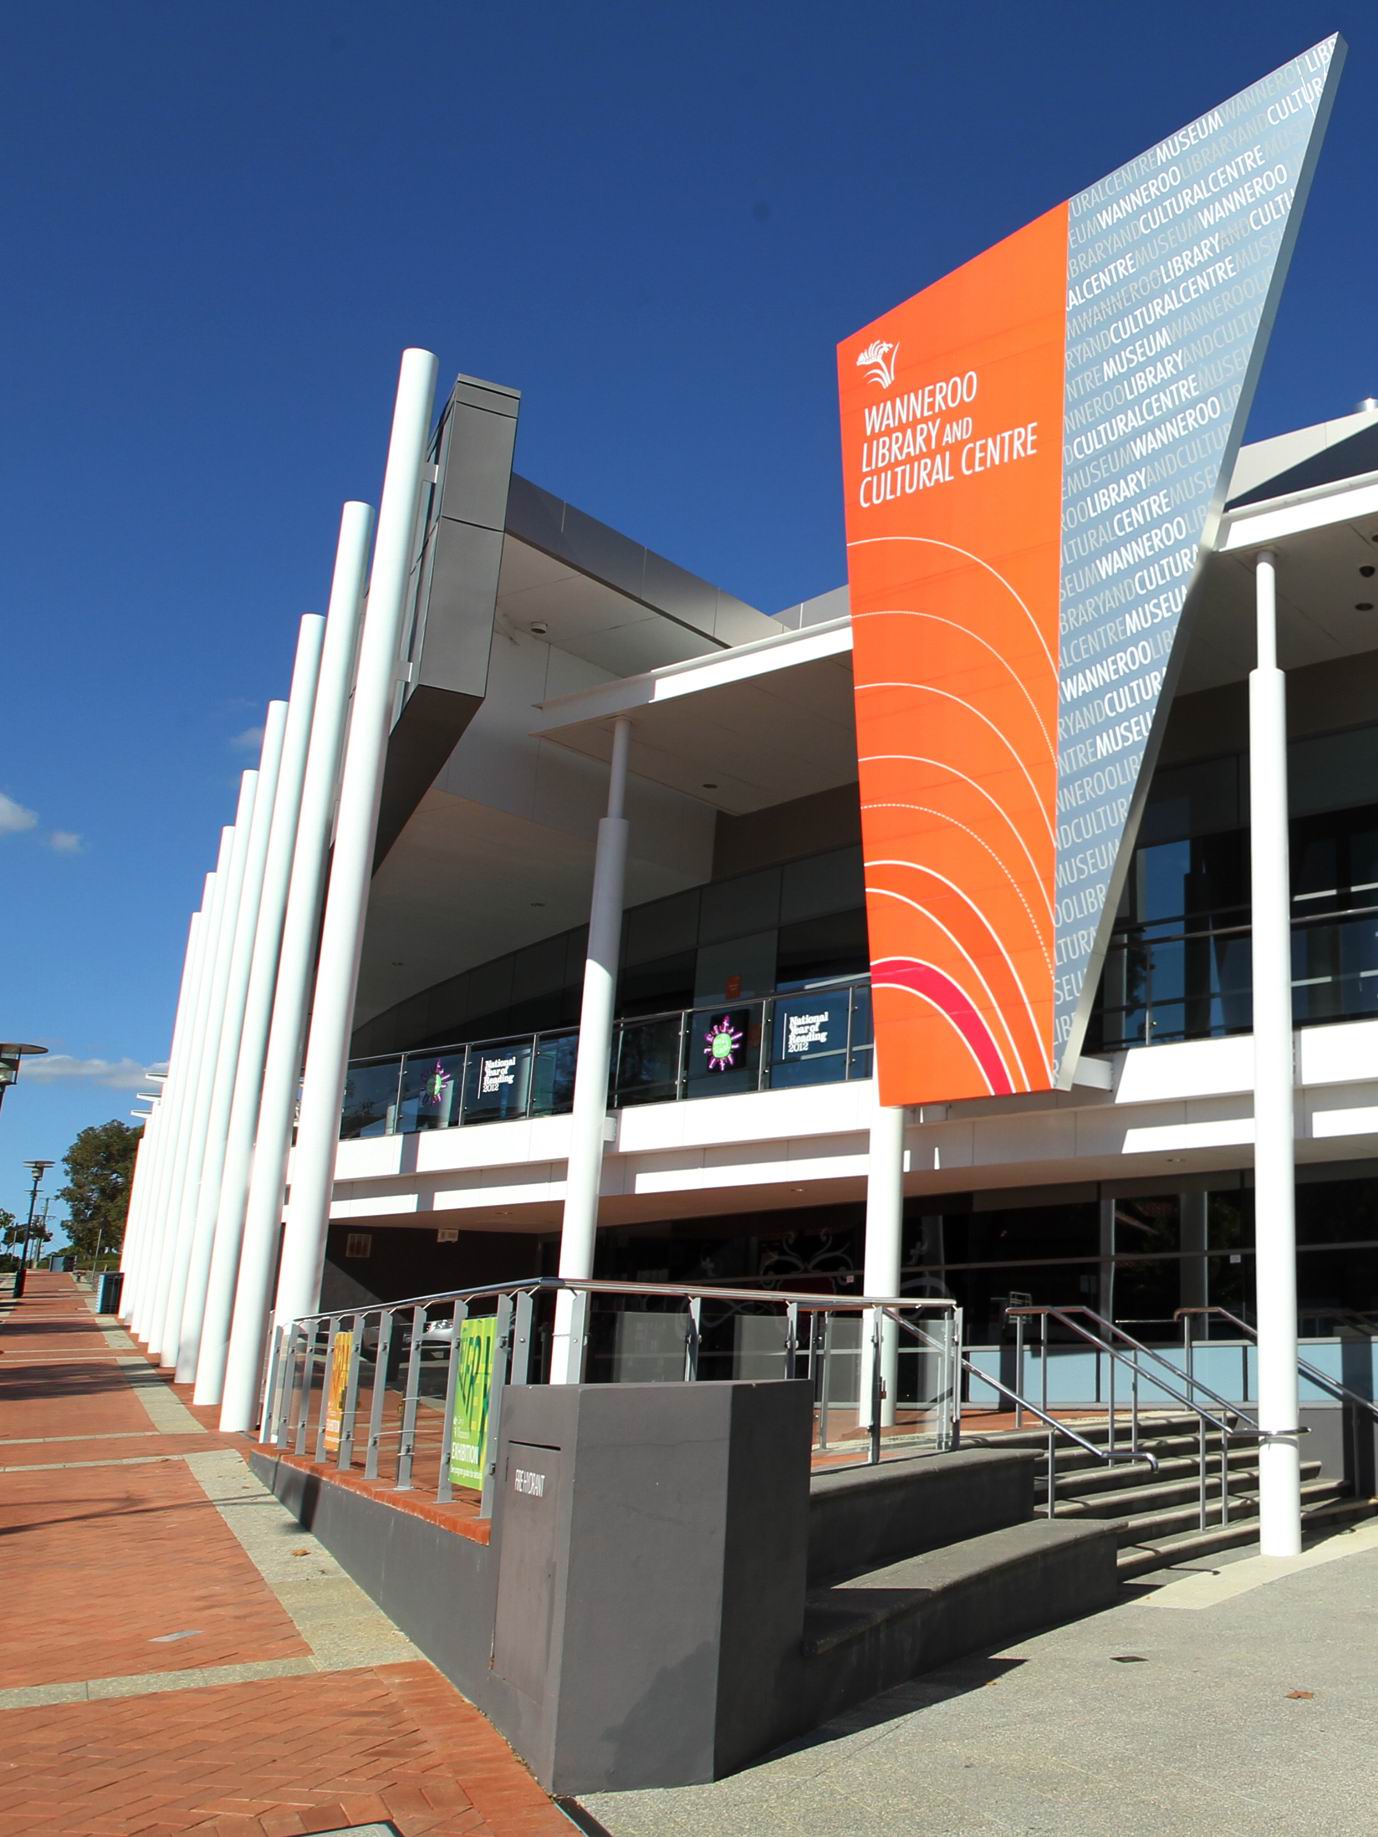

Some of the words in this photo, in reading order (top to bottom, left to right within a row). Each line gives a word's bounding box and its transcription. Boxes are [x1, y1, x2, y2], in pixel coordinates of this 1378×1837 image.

[1156, 111, 1223, 162] MUSEUM
[1096, 165, 1181, 229] WANNEROO
[1066, 254, 1136, 308] ALCENTRE
[1199, 163, 1287, 228] WANNEROO
[1160, 235, 1220, 283] LIBRARY
[1102, 326, 1171, 379] MUSEUM
[1123, 351, 1183, 399] LIBRARY
[864, 371, 977, 436] WANNEROO
[1130, 396, 1220, 459] WANNEROO
[859, 451, 954, 508] CULTURAL
[961, 422, 1038, 476] CENTRE
[862, 418, 941, 472] LIBRARY
[942, 416, 972, 446] AND
[1086, 469, 1146, 516] LIBRARY
[1113, 489, 1171, 536] CENTRE
[1096, 516, 1186, 579] WANNEROO
[1061, 640, 1150, 702] WANNEROO
[1096, 710, 1156, 756] MUSEU
